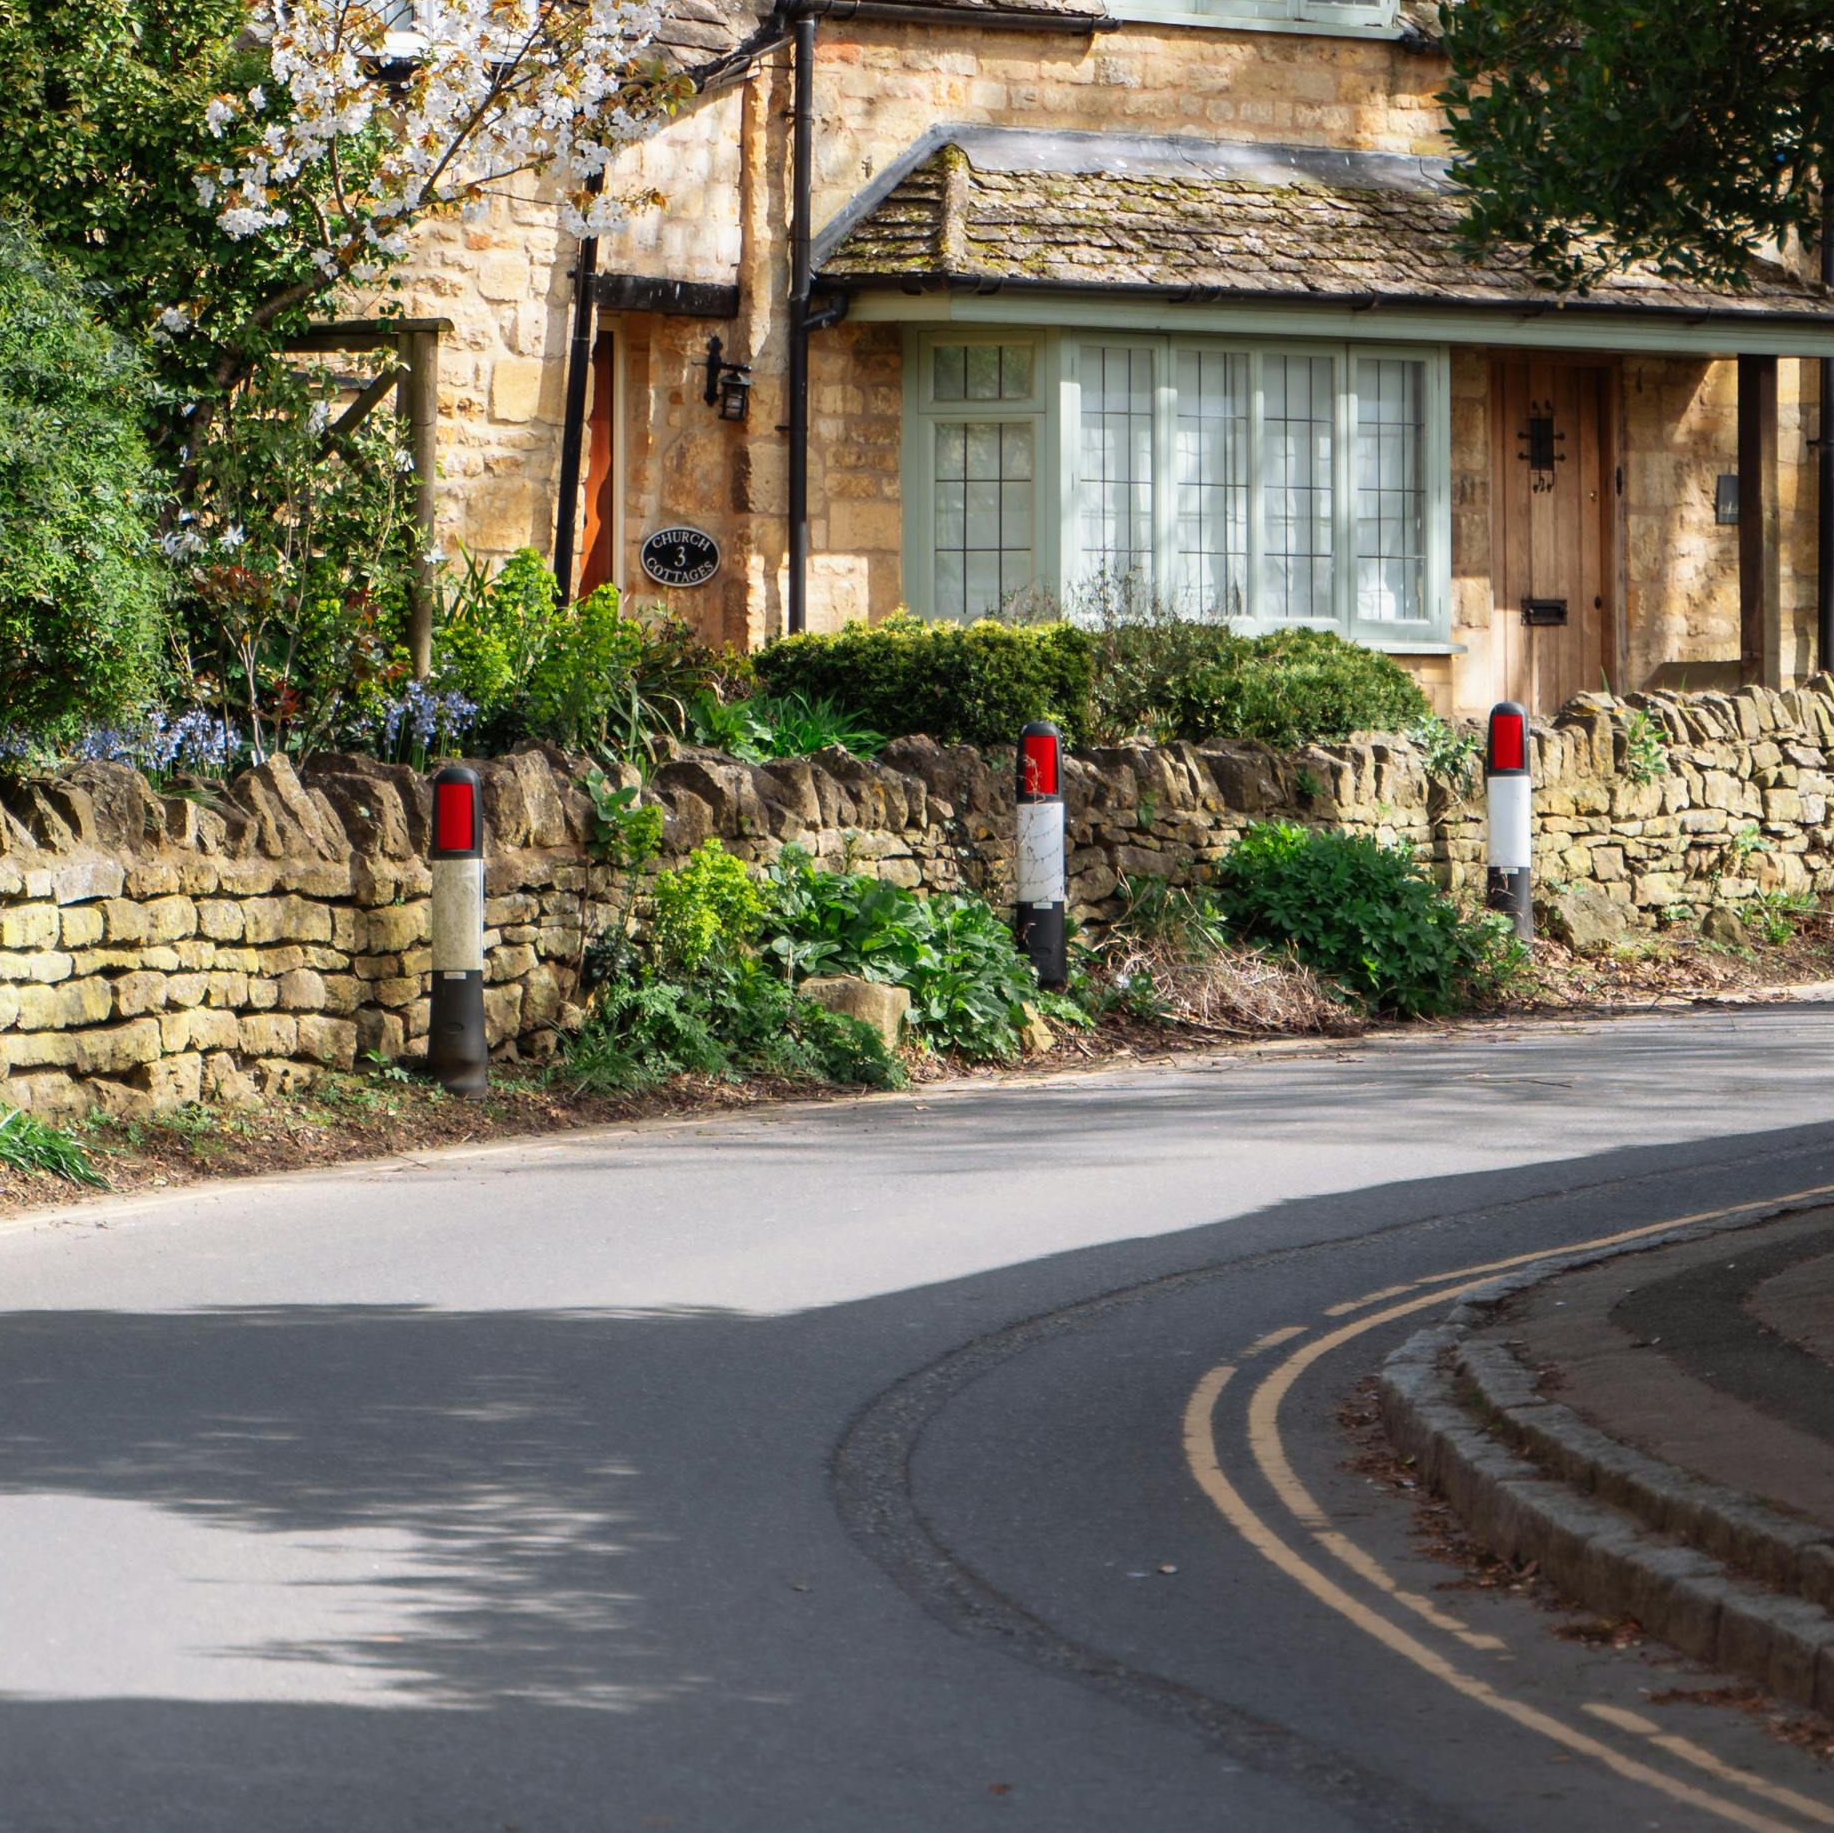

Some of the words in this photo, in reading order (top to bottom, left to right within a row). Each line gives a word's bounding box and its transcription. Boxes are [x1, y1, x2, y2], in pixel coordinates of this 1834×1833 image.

[652, 531, 710, 551] CHURCH
[674, 546, 686, 567] 3
[647, 557, 714, 582] COTTAGES
